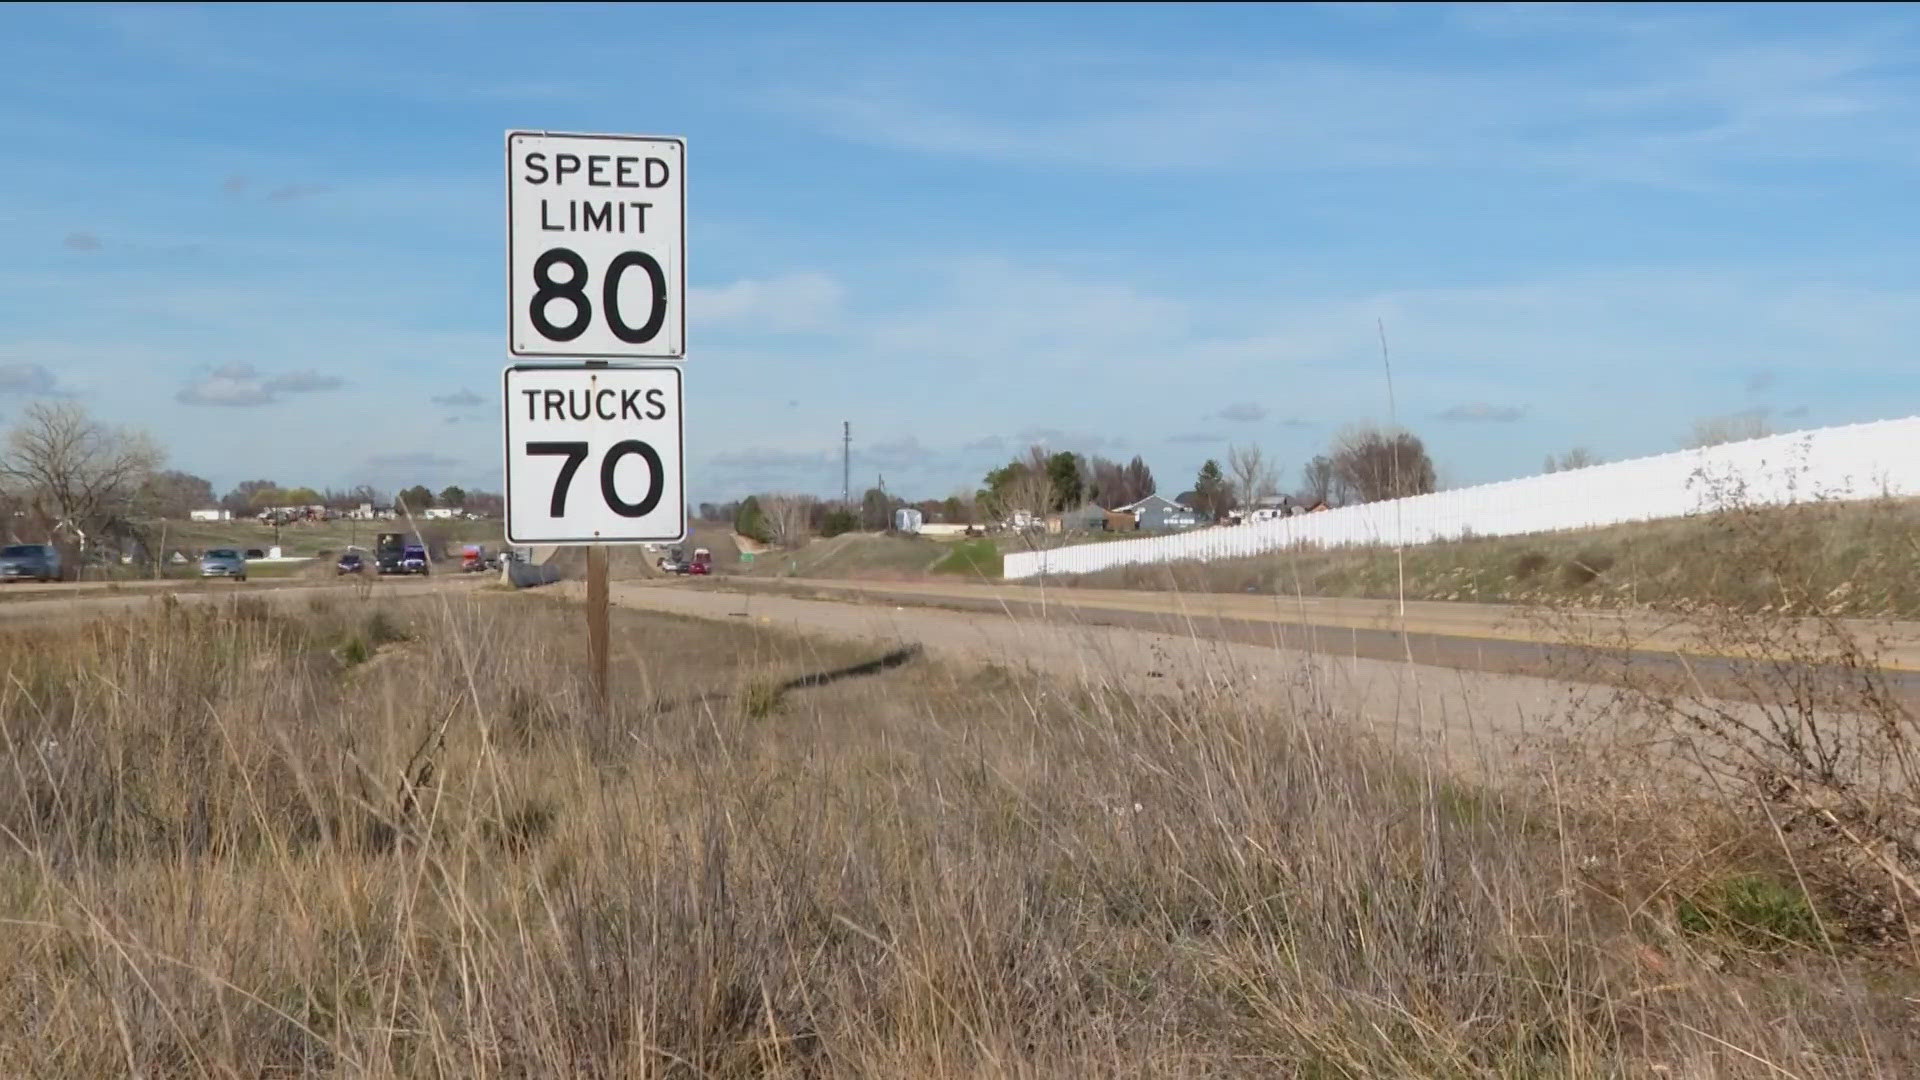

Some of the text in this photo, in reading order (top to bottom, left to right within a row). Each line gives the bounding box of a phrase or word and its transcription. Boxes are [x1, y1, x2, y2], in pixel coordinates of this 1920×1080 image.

[525, 152, 670, 189] SPEED
[541, 199, 653, 234] LIMIT
[529, 247, 668, 344] 80
[522, 389, 666, 421] TRUCKS
[526, 439, 664, 518] 70
